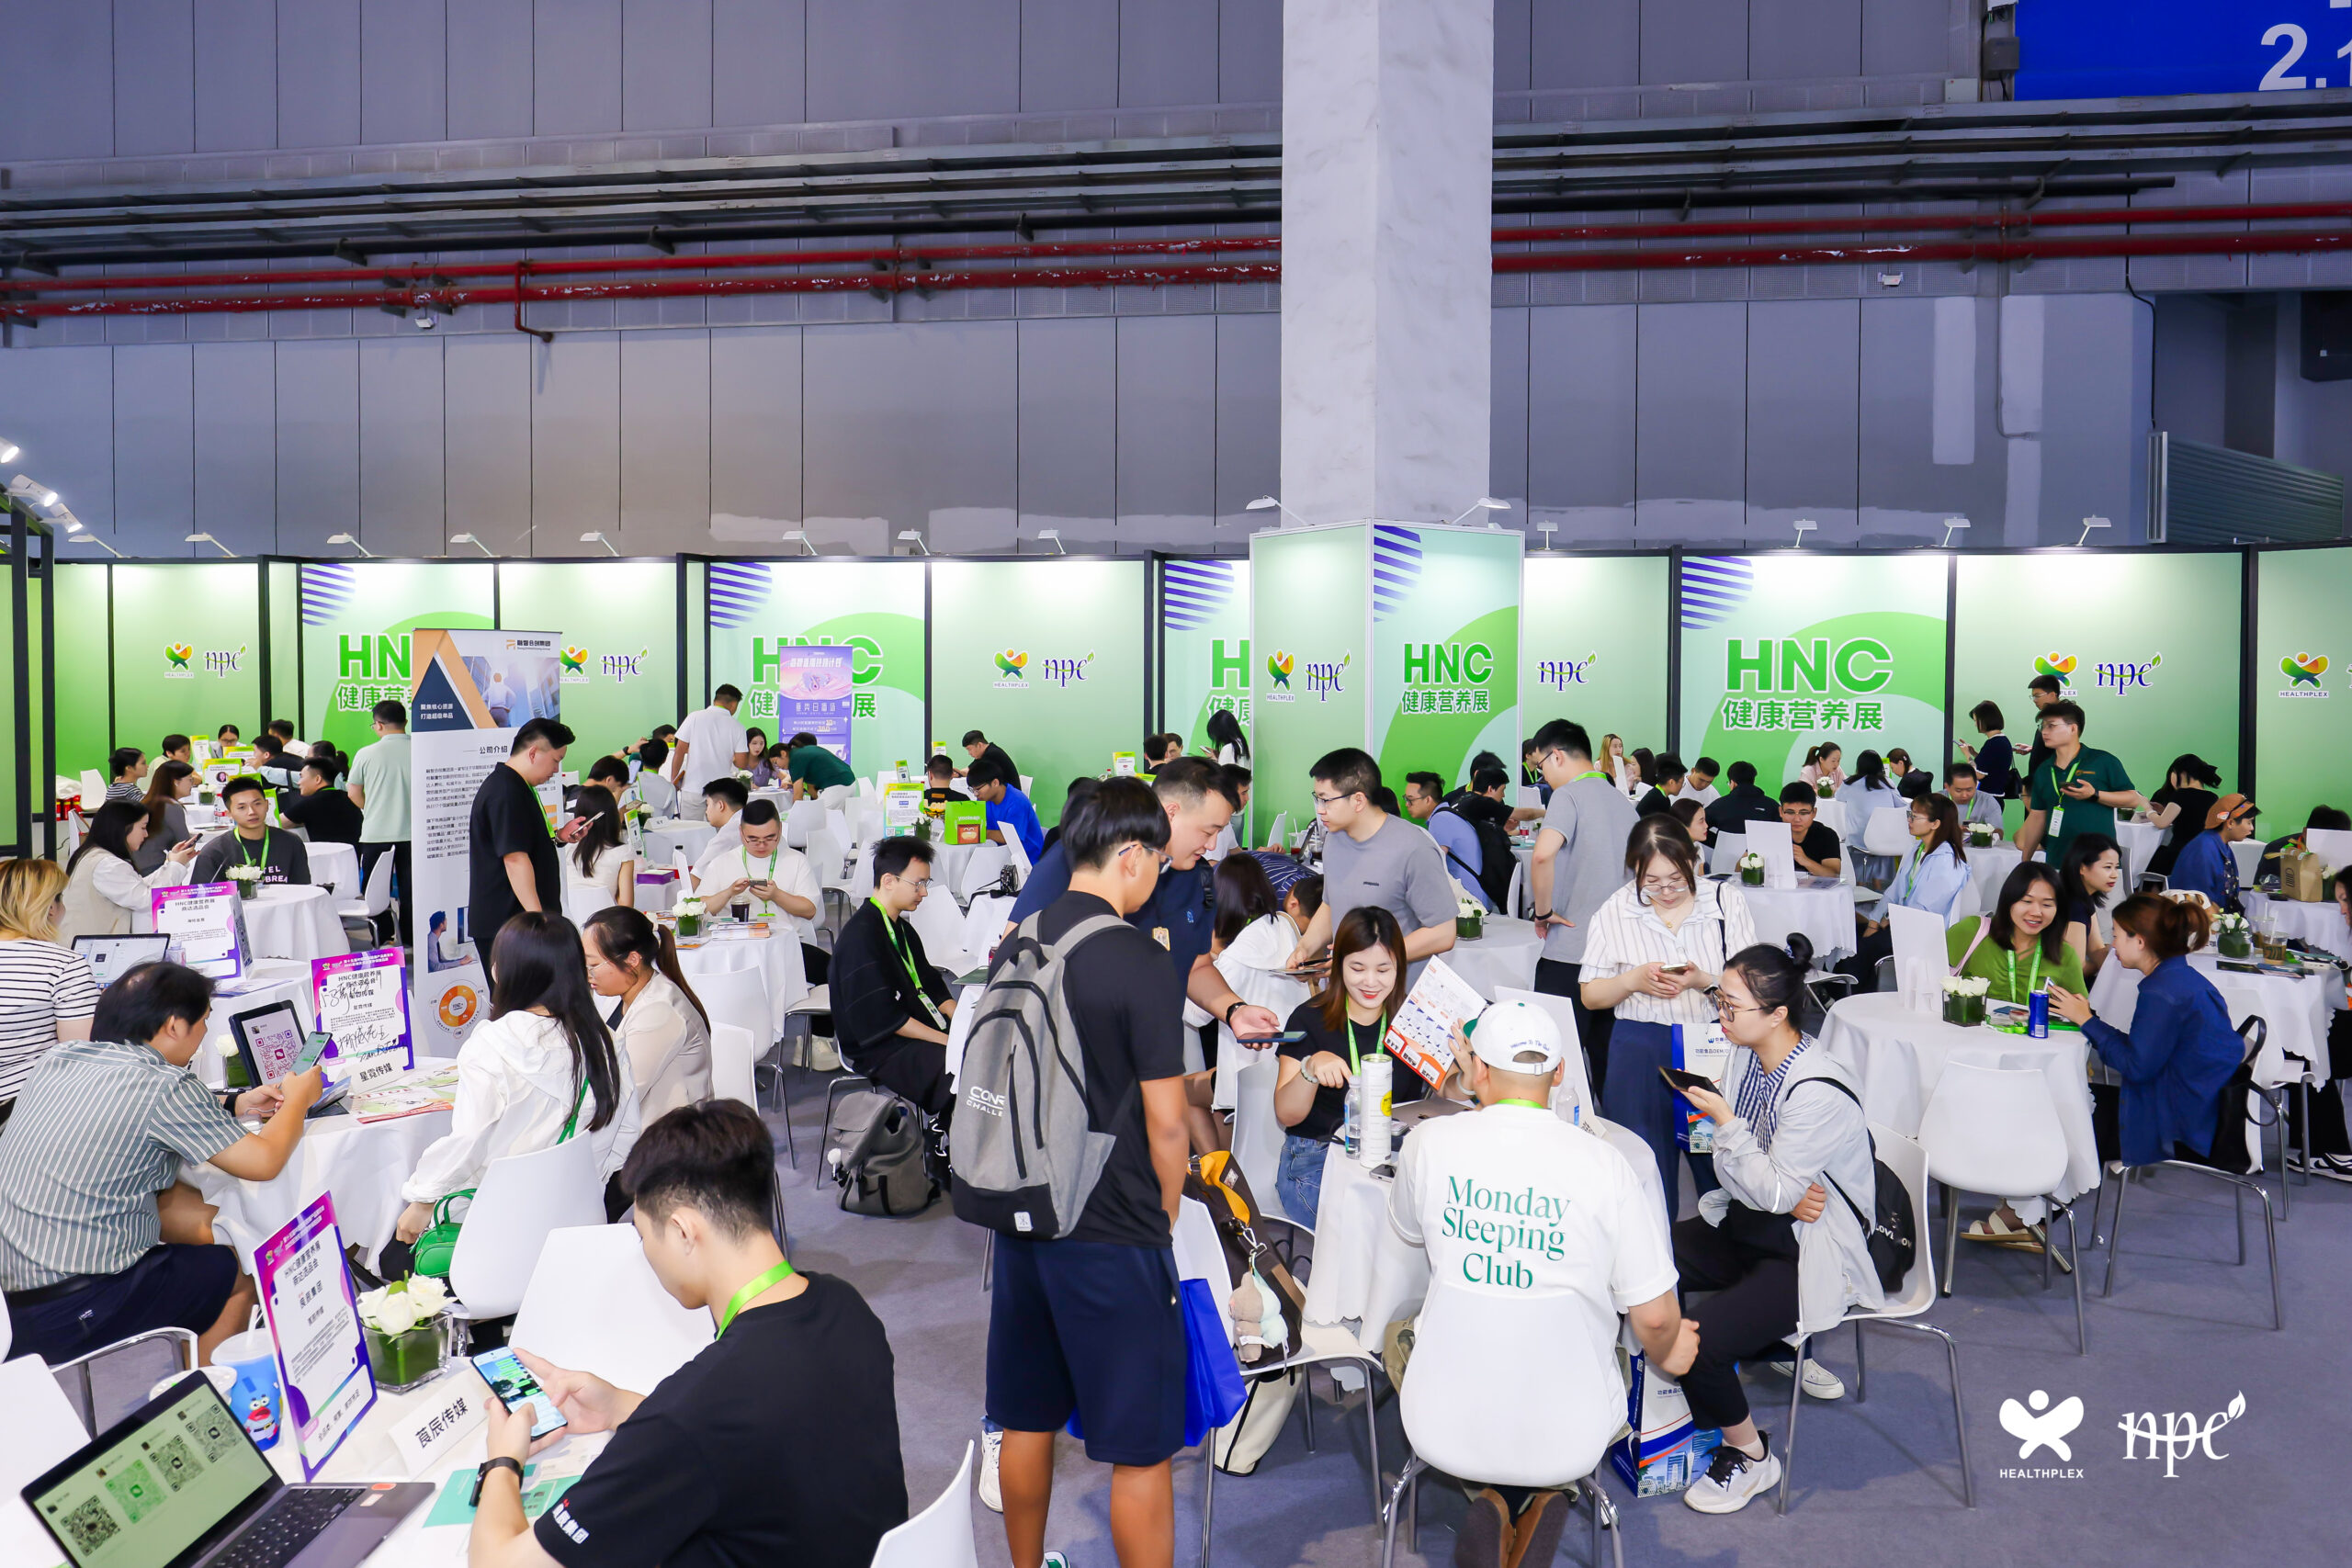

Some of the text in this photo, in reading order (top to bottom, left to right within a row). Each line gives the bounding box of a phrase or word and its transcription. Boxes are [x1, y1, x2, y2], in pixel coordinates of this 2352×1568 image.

[339, 635, 411, 678] HN
[752, 636, 882, 685] HC
[1043, 654, 1091, 686] npc
[1404, 643, 1493, 684] HNC
[1538, 658, 1591, 691] npc
[1727, 639, 1892, 693] HNC
[1306, 656, 1348, 701] npc
[2096, 658, 2156, 695] npc
[338, 685, 412, 710] 健康营
[1403, 690, 1488, 713] 健康营养展
[1724, 701, 1883, 730] 健康营养展
[479, 745, 508, 754] 公司介绍
[1446, 1175, 1571, 1226] Monday
[1442, 1207, 1566, 1261] Sleeping
[1463, 1252, 1533, 1290] Club
